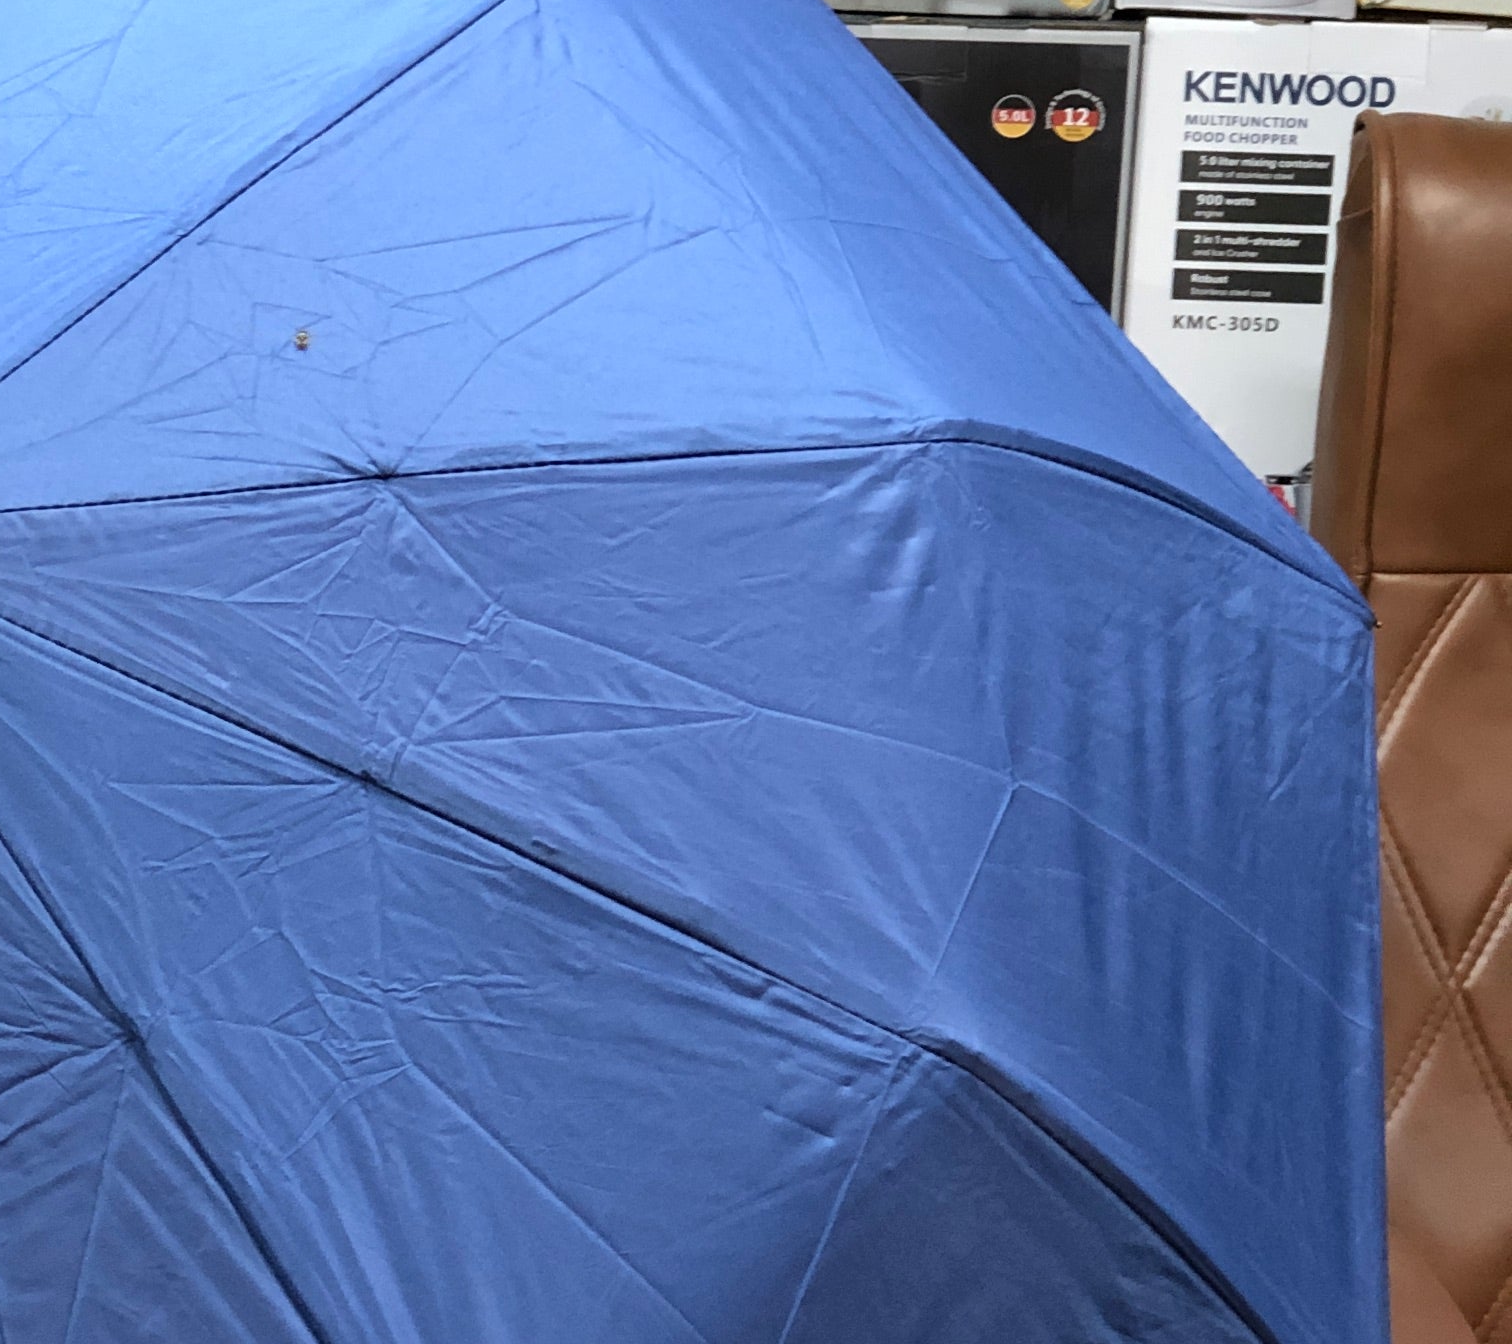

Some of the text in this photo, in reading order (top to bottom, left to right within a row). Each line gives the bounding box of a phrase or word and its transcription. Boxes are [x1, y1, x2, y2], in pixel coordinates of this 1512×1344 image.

[1182, 69, 1397, 109] KENWOOD
[1062, 106, 1092, 127] 12
[1183, 113, 1309, 129] MULTIFUNCTION
[1183, 130, 1299, 146] FOOD CHOPPER
[1196, 193, 1257, 207] 900 watts
[1172, 314, 1281, 333] KMC-305D
